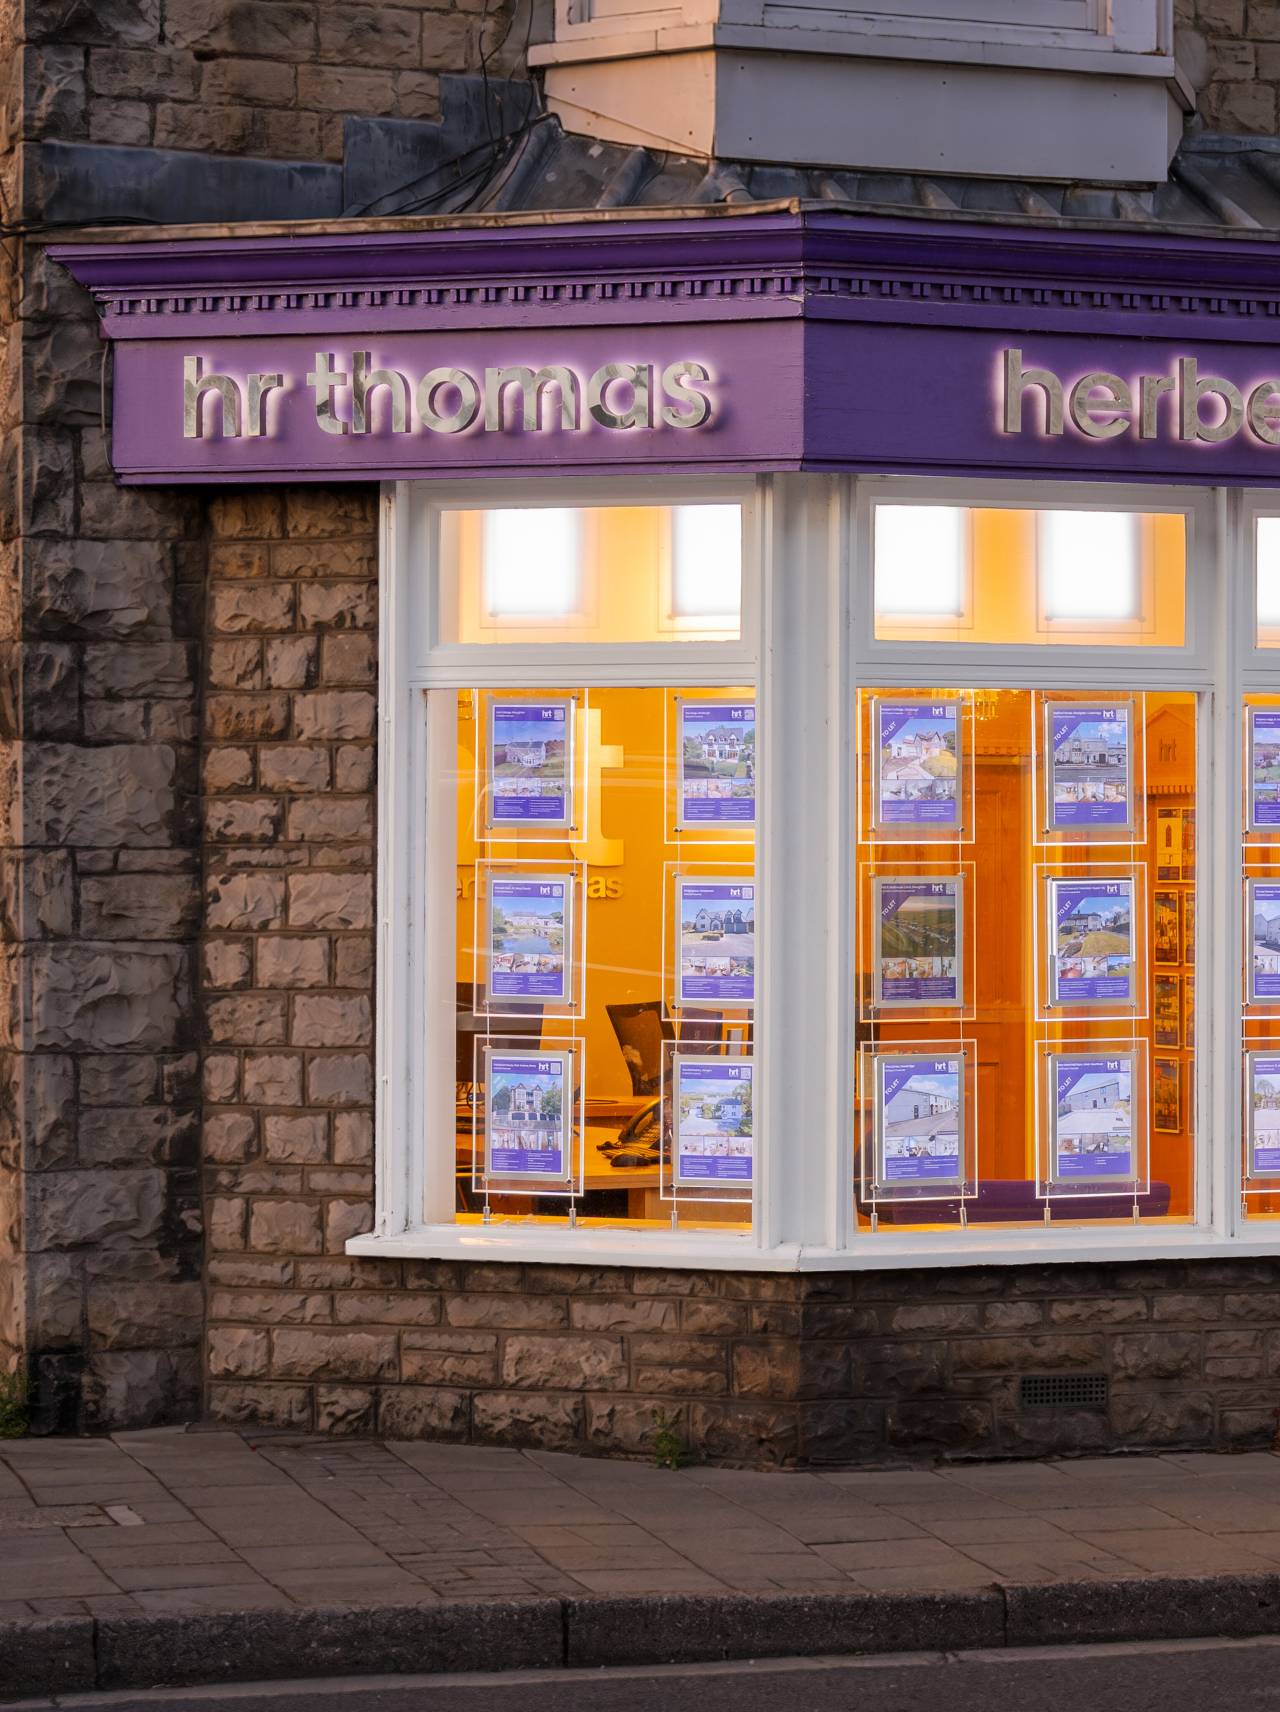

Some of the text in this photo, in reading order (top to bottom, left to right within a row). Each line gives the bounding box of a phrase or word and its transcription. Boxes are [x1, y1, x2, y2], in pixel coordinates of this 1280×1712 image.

[183, 350, 712, 439] hr thomas
[932, 706, 943, 715] hrt
[1103, 710, 1114, 718] hrt
[932, 883, 943, 892] hrt
[1107, 885, 1117, 893] hrt
[935, 1062, 946, 1070] hrt
[1107, 1062, 1118, 1070] hrt
